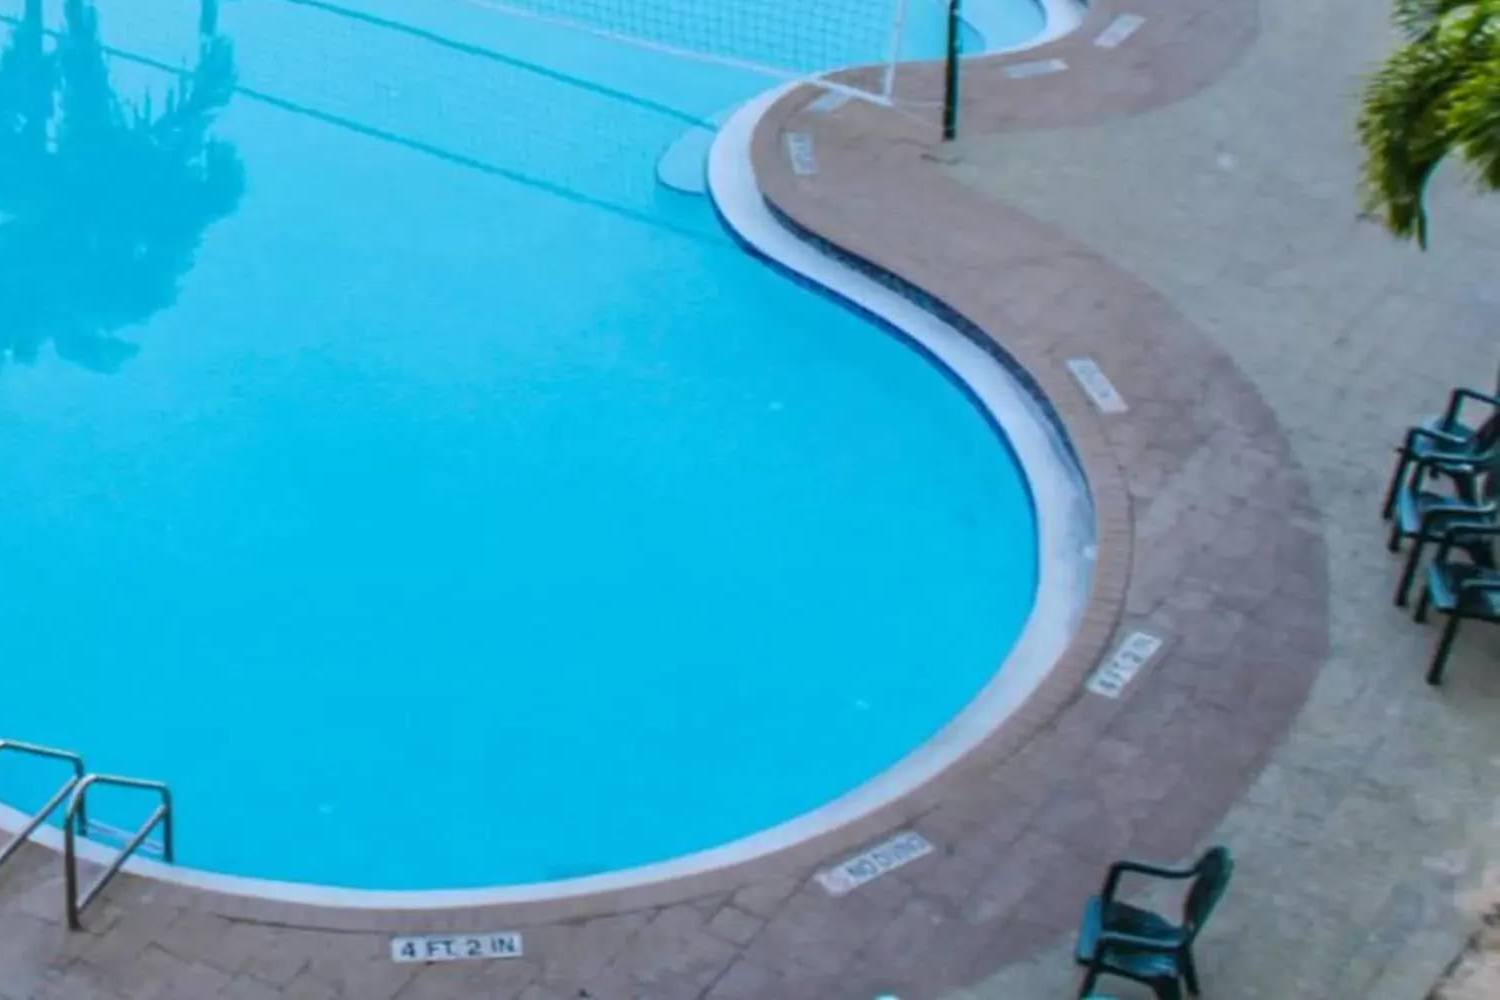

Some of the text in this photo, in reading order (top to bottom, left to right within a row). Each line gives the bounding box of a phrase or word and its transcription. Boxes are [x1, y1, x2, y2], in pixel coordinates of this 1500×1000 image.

[400, 936, 516, 957] 4 FT 2 IN
